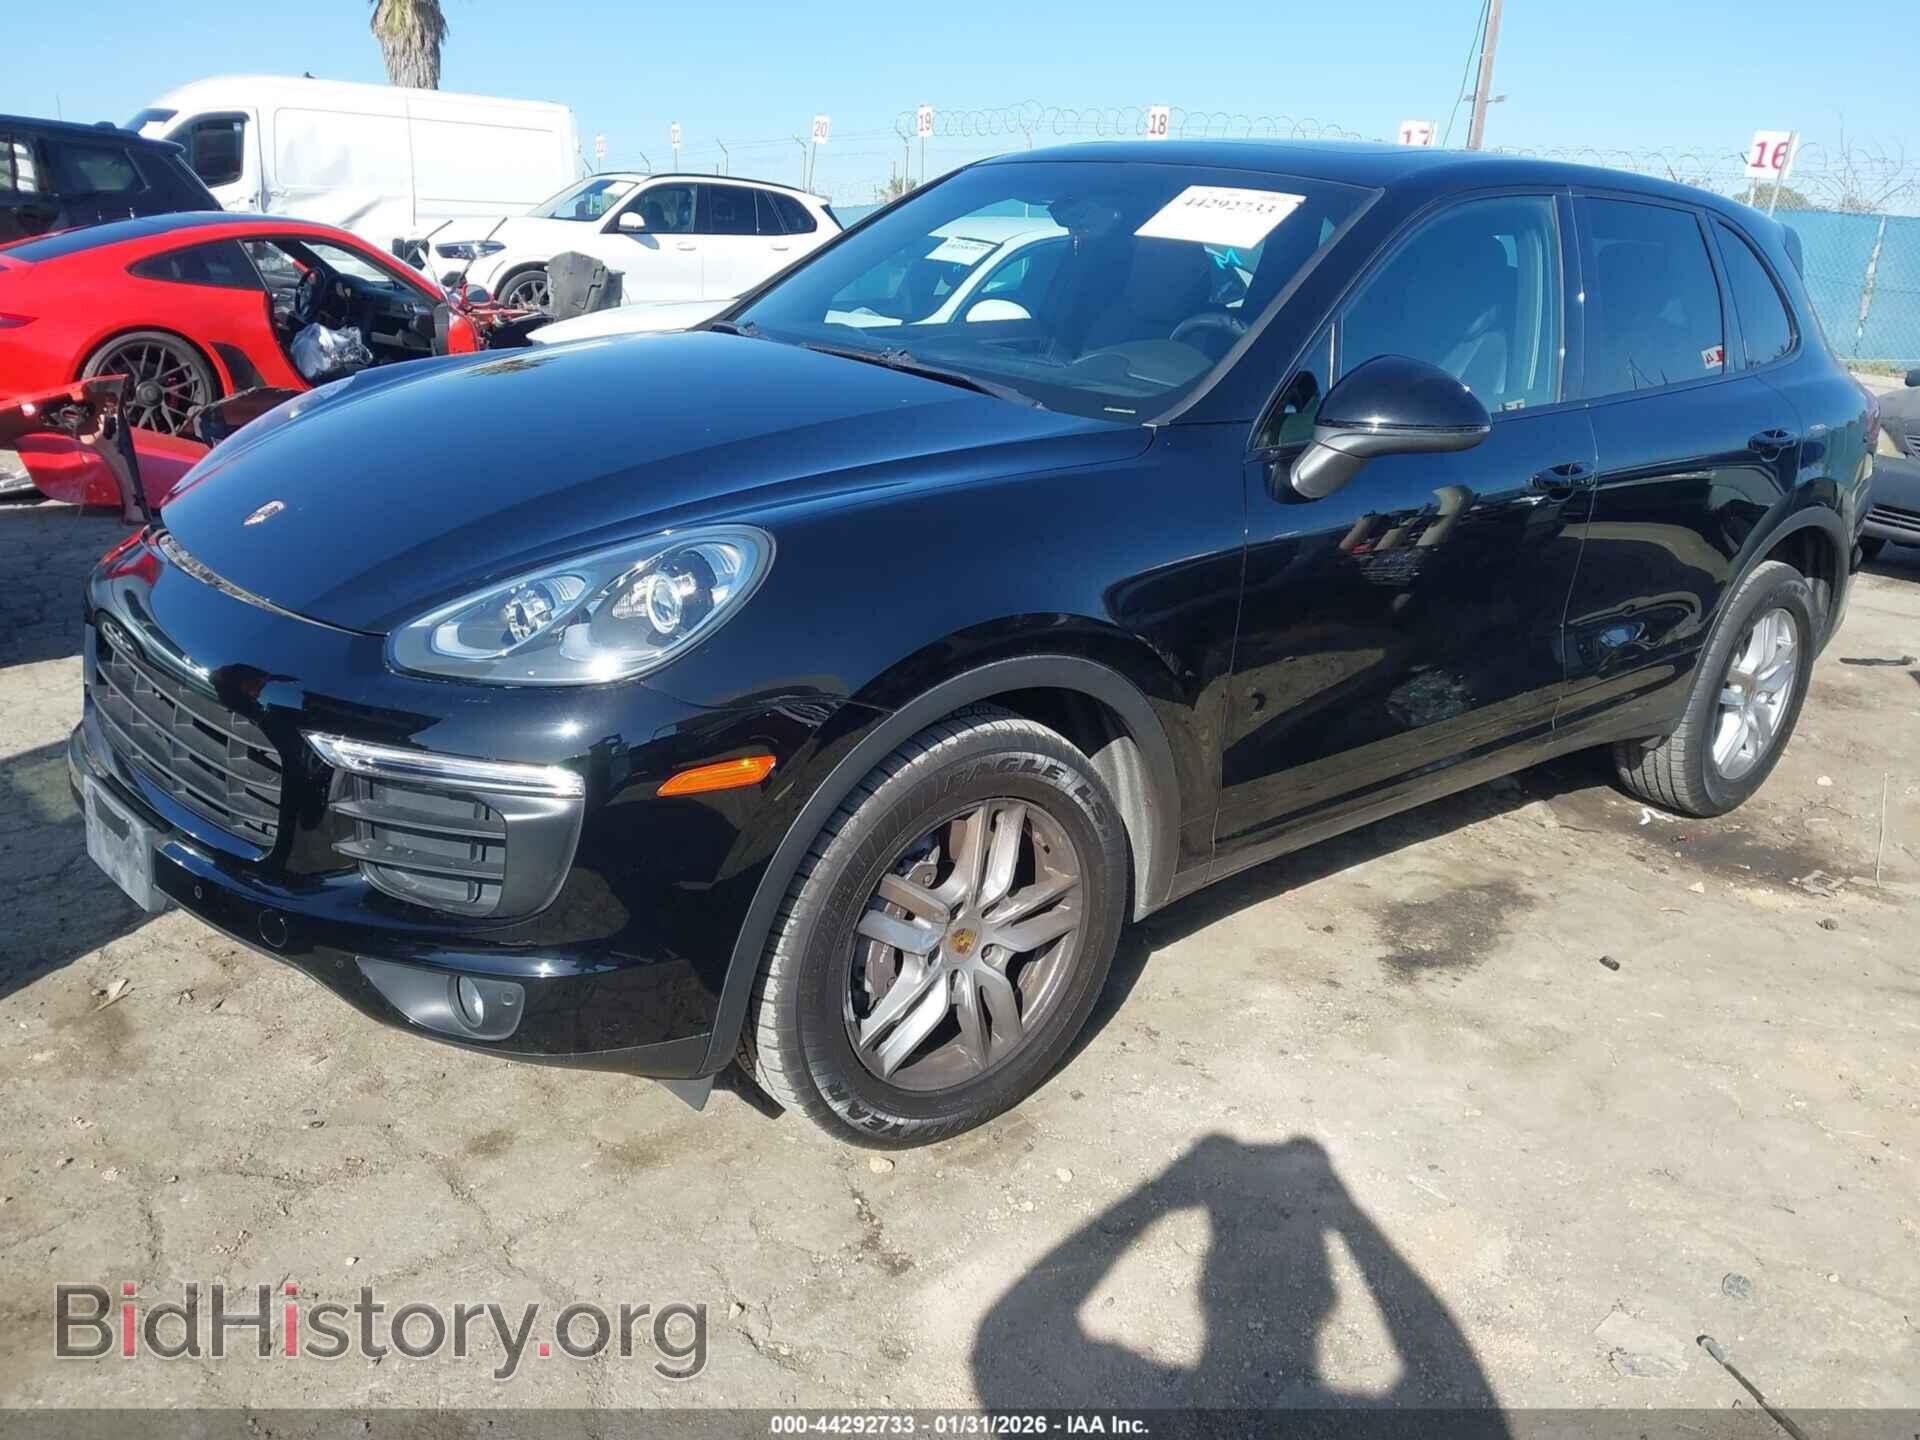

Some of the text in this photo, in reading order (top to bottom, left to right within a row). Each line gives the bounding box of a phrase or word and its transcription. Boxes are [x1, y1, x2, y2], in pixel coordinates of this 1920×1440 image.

[814, 118, 828, 139] 20
[919, 111, 931, 132] 19
[1150, 114, 1168, 136] 18
[1750, 141, 1788, 170] 16
